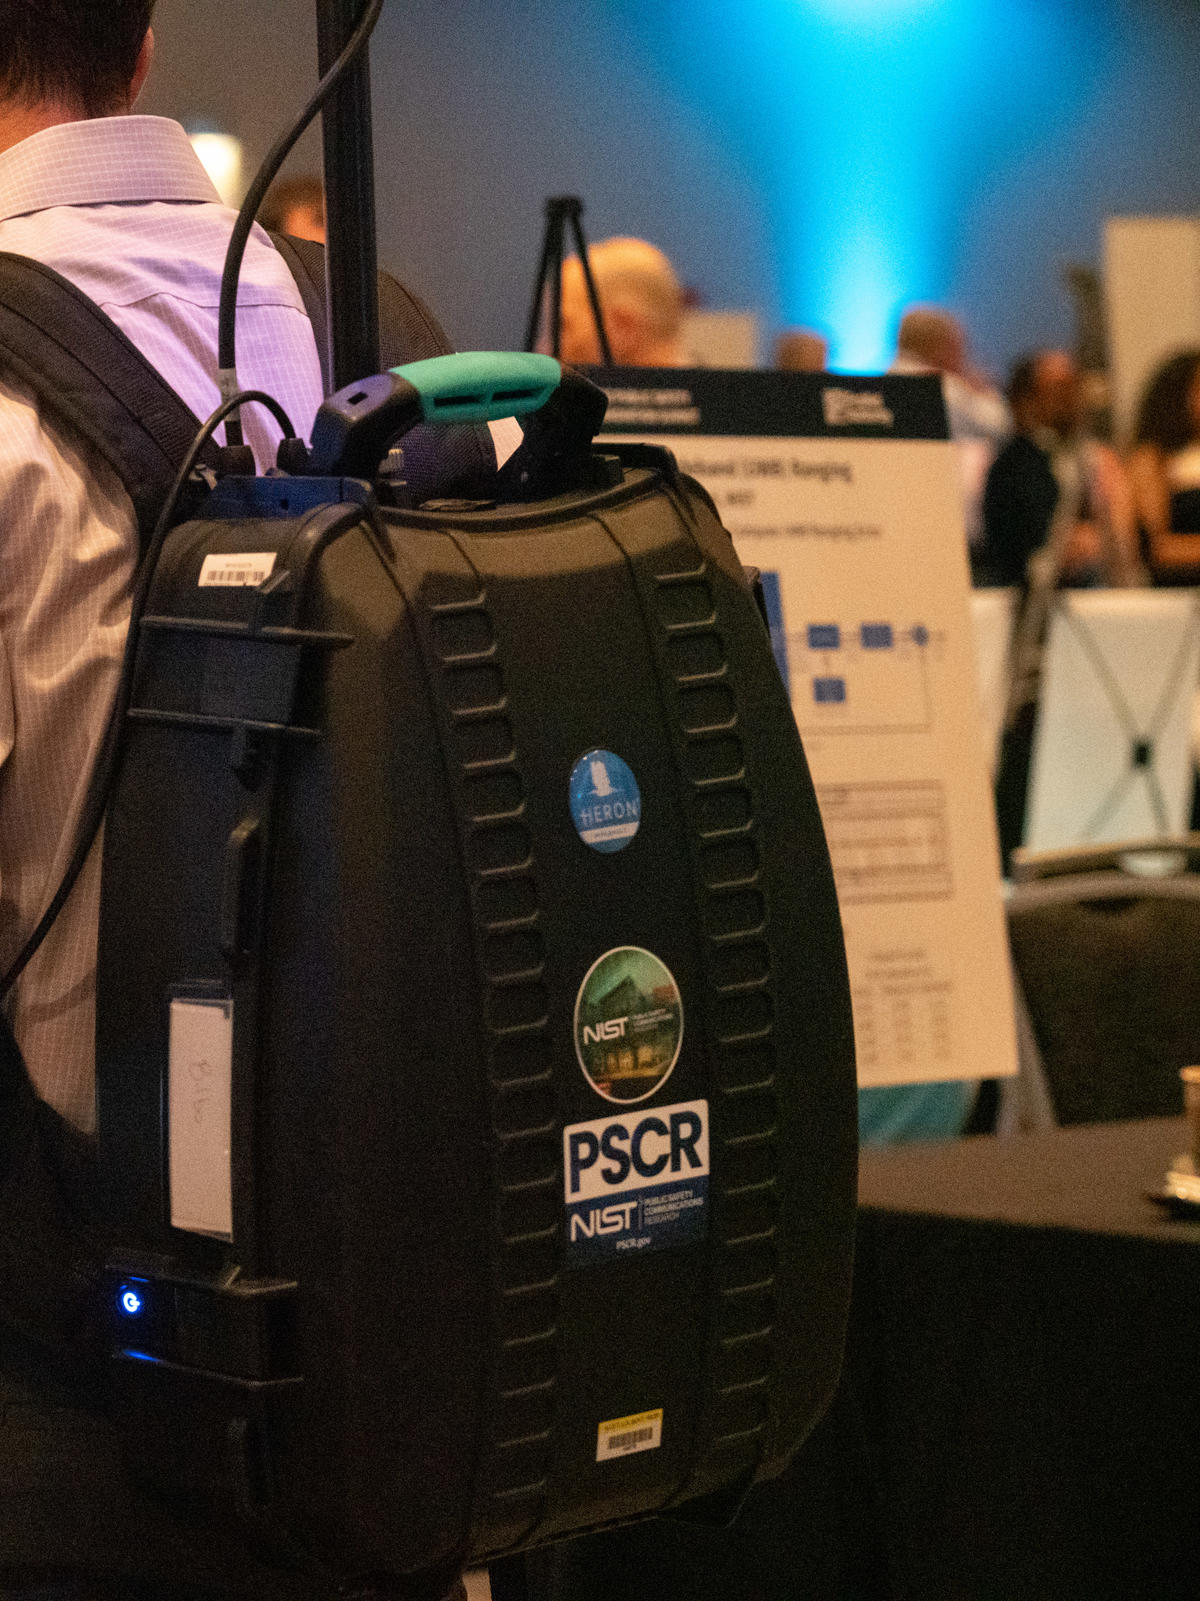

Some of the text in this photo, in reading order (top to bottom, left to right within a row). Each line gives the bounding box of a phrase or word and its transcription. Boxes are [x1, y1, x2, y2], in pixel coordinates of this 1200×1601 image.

[580, 797, 640, 827] HERON
[583, 1016, 629, 1045] NIST
[569, 1110, 703, 1194] PSCR
[570, 1201, 638, 1242] NIST
